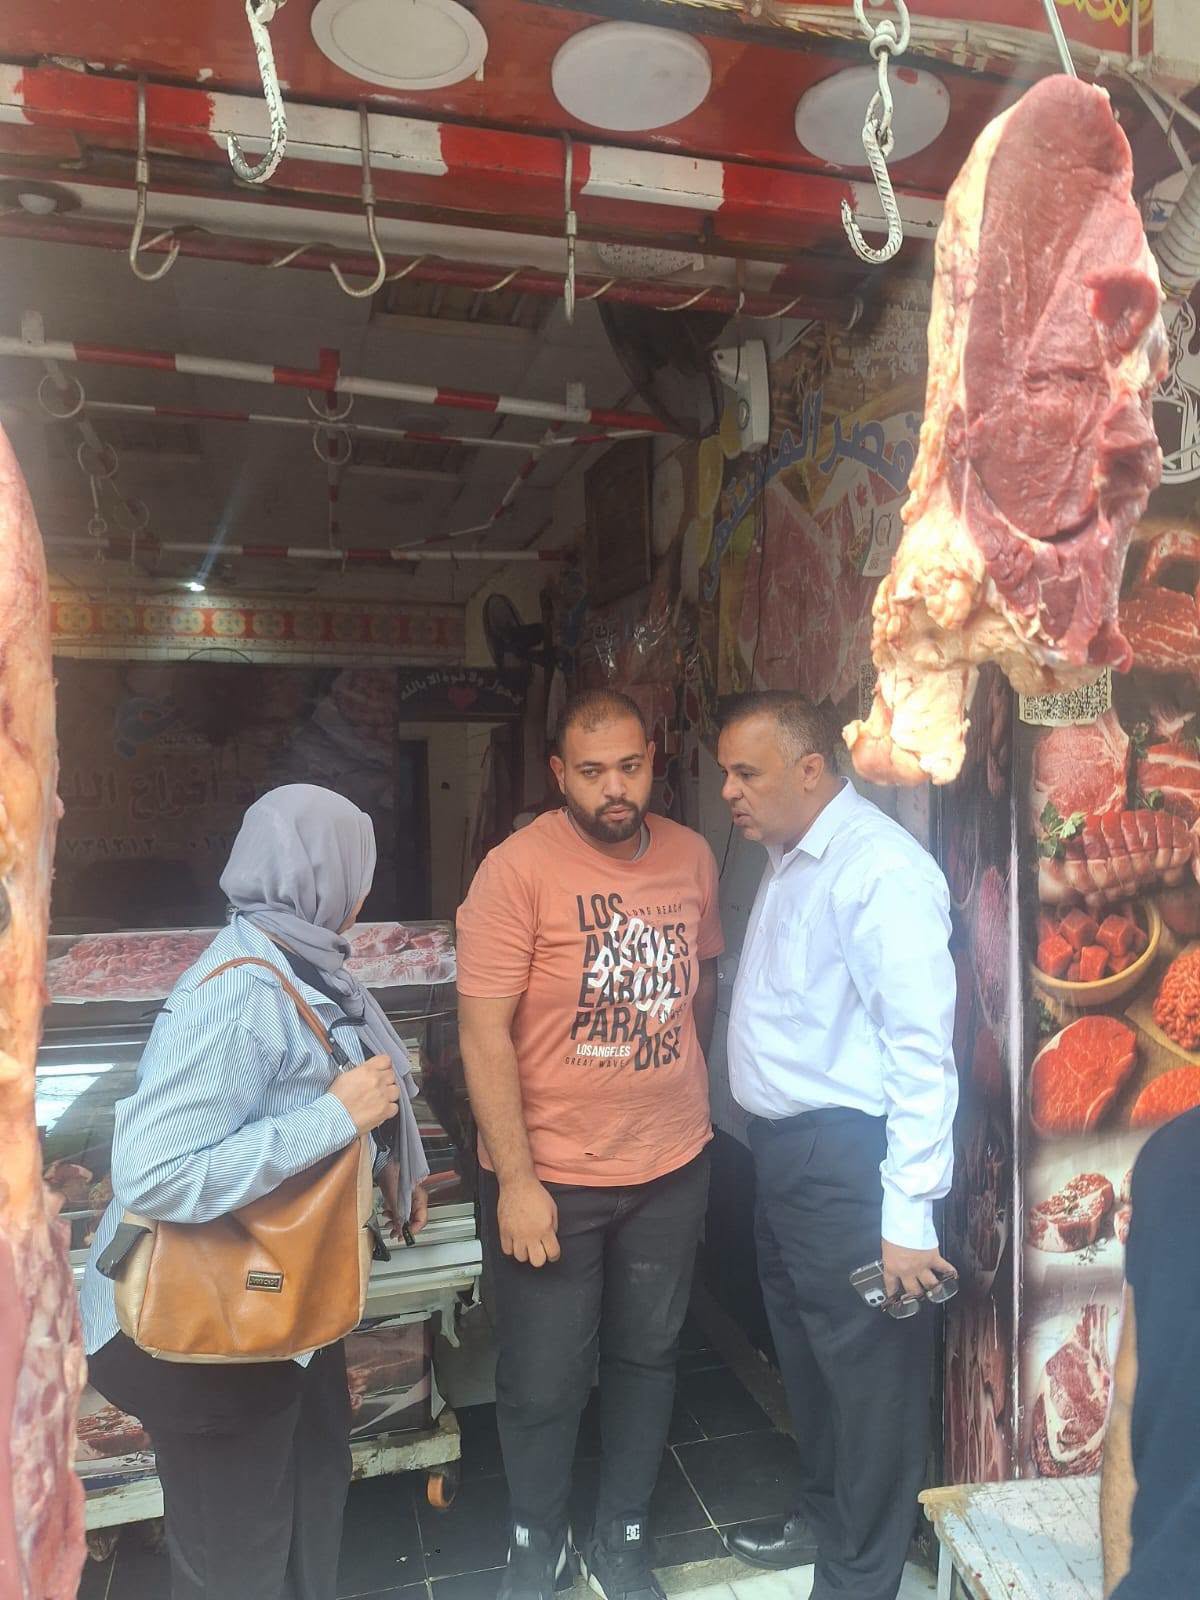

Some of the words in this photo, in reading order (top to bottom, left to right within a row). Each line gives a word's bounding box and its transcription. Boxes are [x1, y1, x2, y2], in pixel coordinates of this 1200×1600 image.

[576, 893, 628, 931] LOS
[626, 906, 652, 917] LONG
[656, 903, 682, 915] BEACH
[583, 922, 689, 968] ANGELES
[570, 1006, 650, 1042] PARA
[565, 1056, 593, 1067] GREAT
[577, 1043, 631, 1058] LOSANGELES
